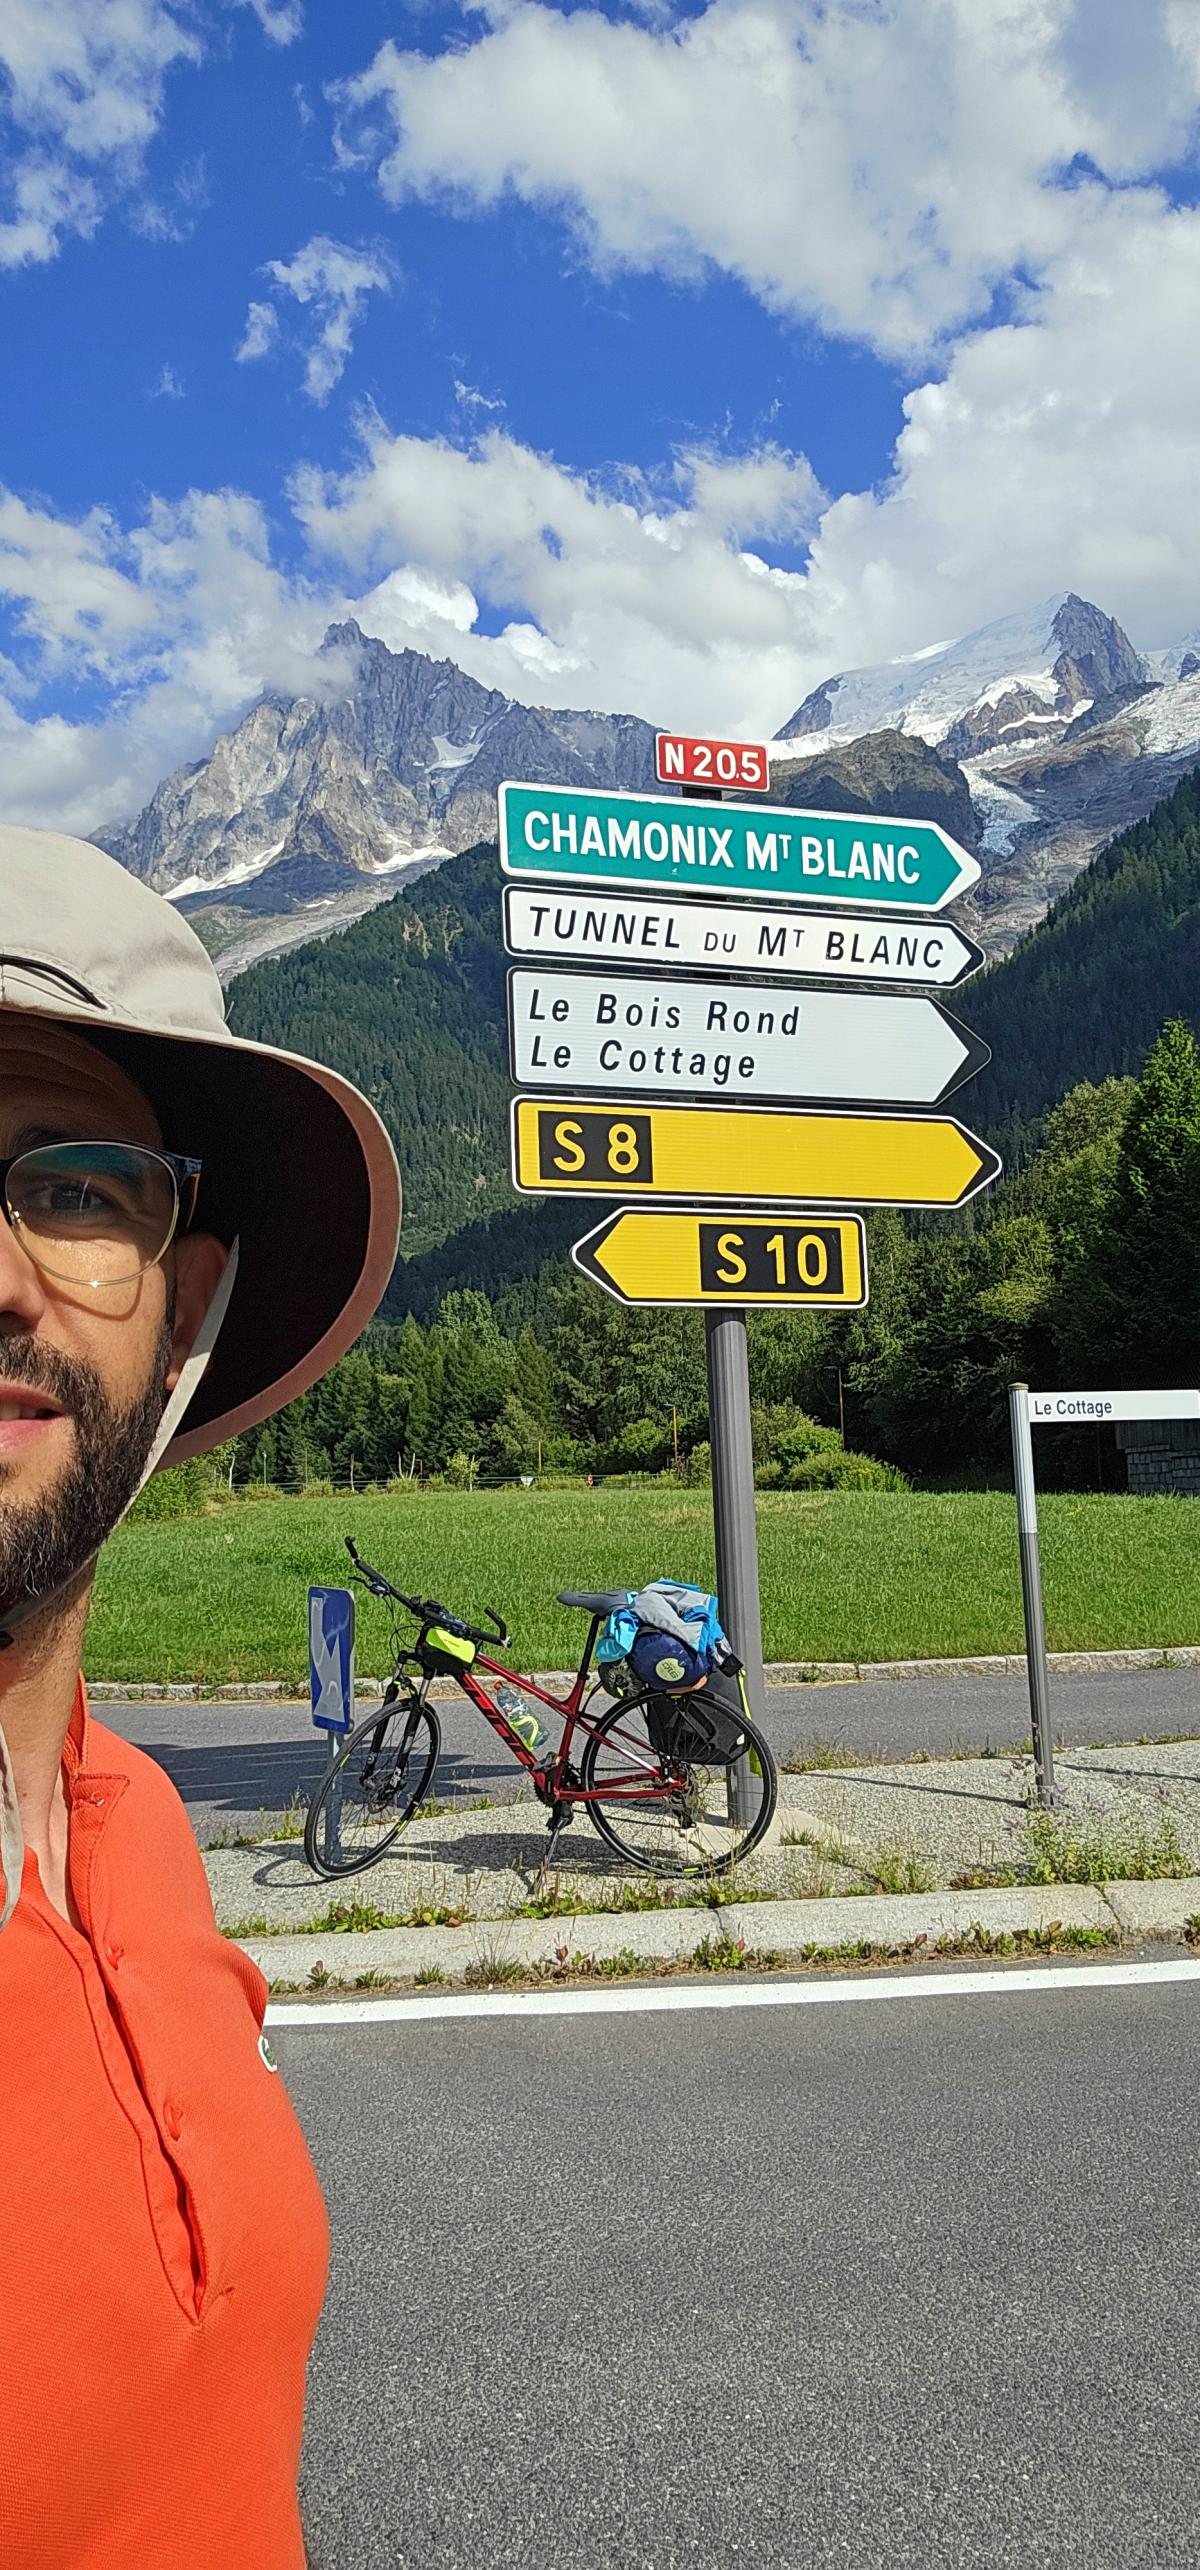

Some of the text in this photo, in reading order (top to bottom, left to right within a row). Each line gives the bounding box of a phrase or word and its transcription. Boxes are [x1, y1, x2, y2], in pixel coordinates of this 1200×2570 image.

[664, 742, 684, 775] N
[523, 810, 735, 869] CHAMONIX
[802, 836, 921, 885] BLANC
[529, 906, 681, 949] TUNNEL
[703, 931, 737, 954] DU
[825, 930, 945, 969] BLANC
[529, 989, 800, 1036] Le Bois Rond
[530, 1036, 756, 1085] Le Cottage
[553, 1120, 640, 1175] S 8
[715, 1233, 829, 1287] S 10
[1034, 1399, 1113, 1418] Le Cottage
